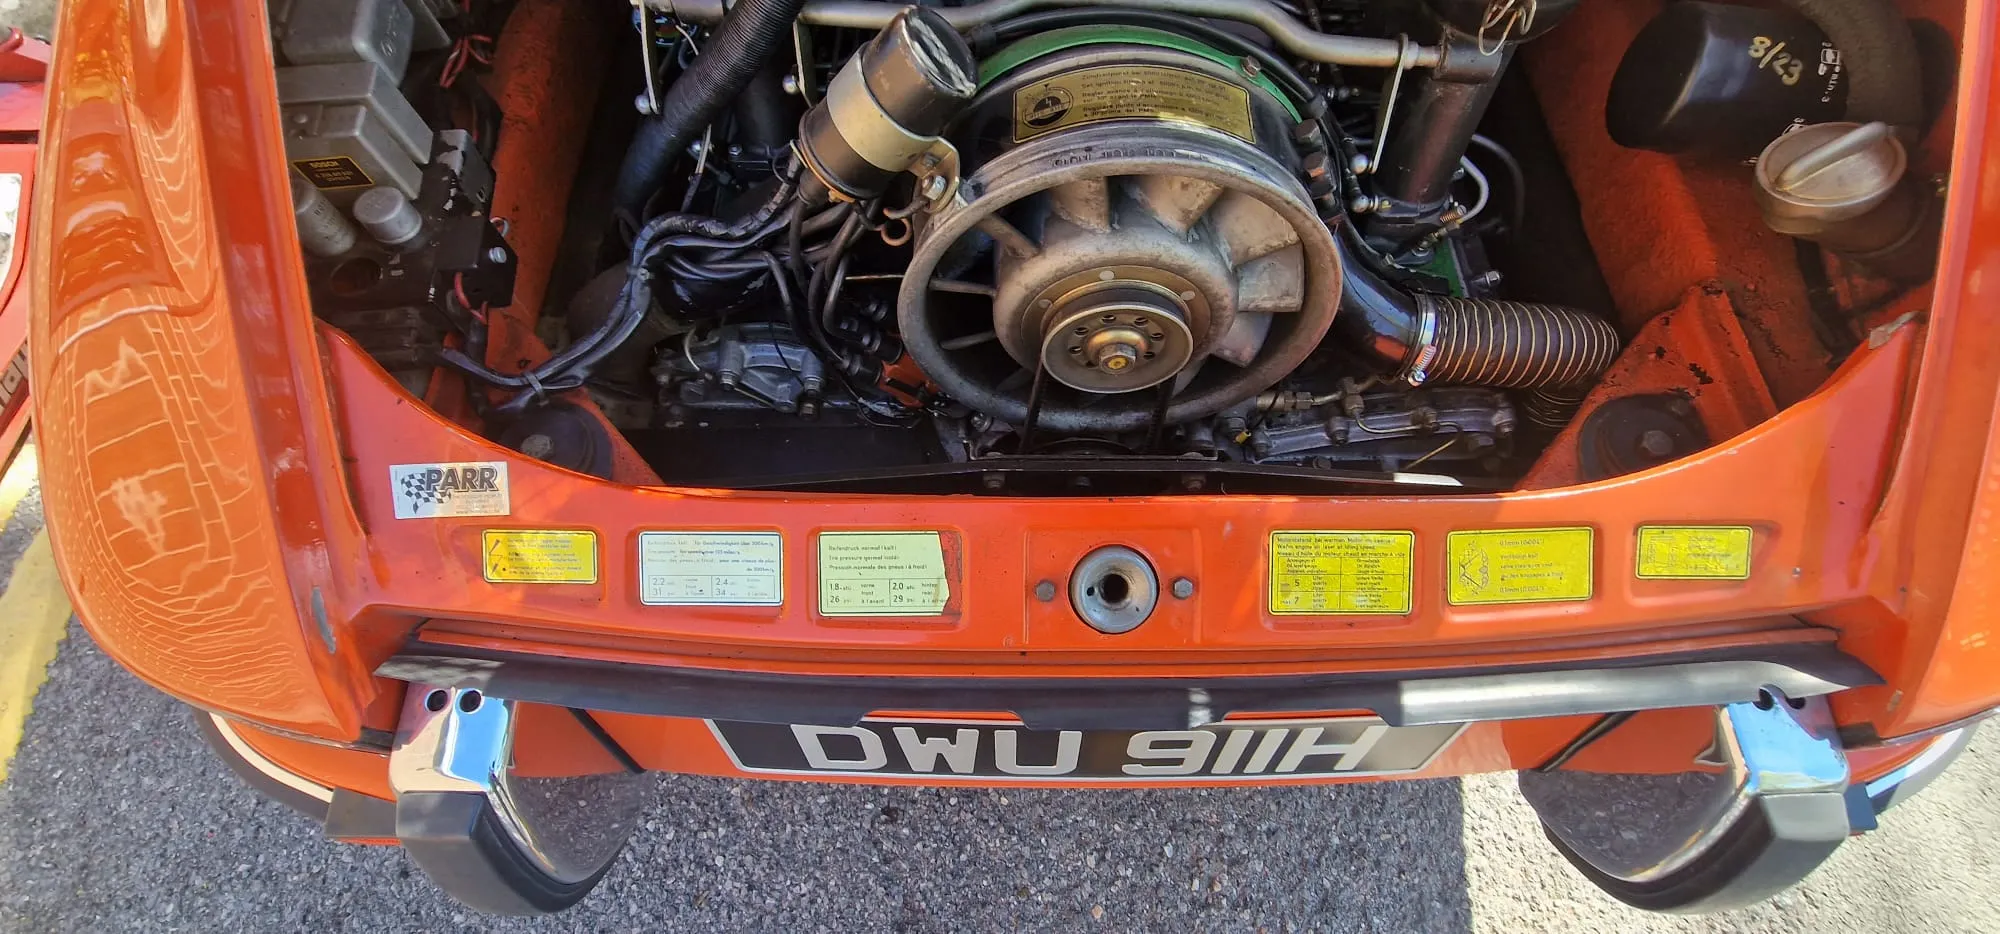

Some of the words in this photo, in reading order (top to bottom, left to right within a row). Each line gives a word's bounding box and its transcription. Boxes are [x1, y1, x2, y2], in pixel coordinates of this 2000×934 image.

[1747, 36, 1803, 85] 8/23
[425, 466, 498, 491] PARR
[790, 724, 1082, 775] DWU
[1121, 725, 1388, 775] 911H
